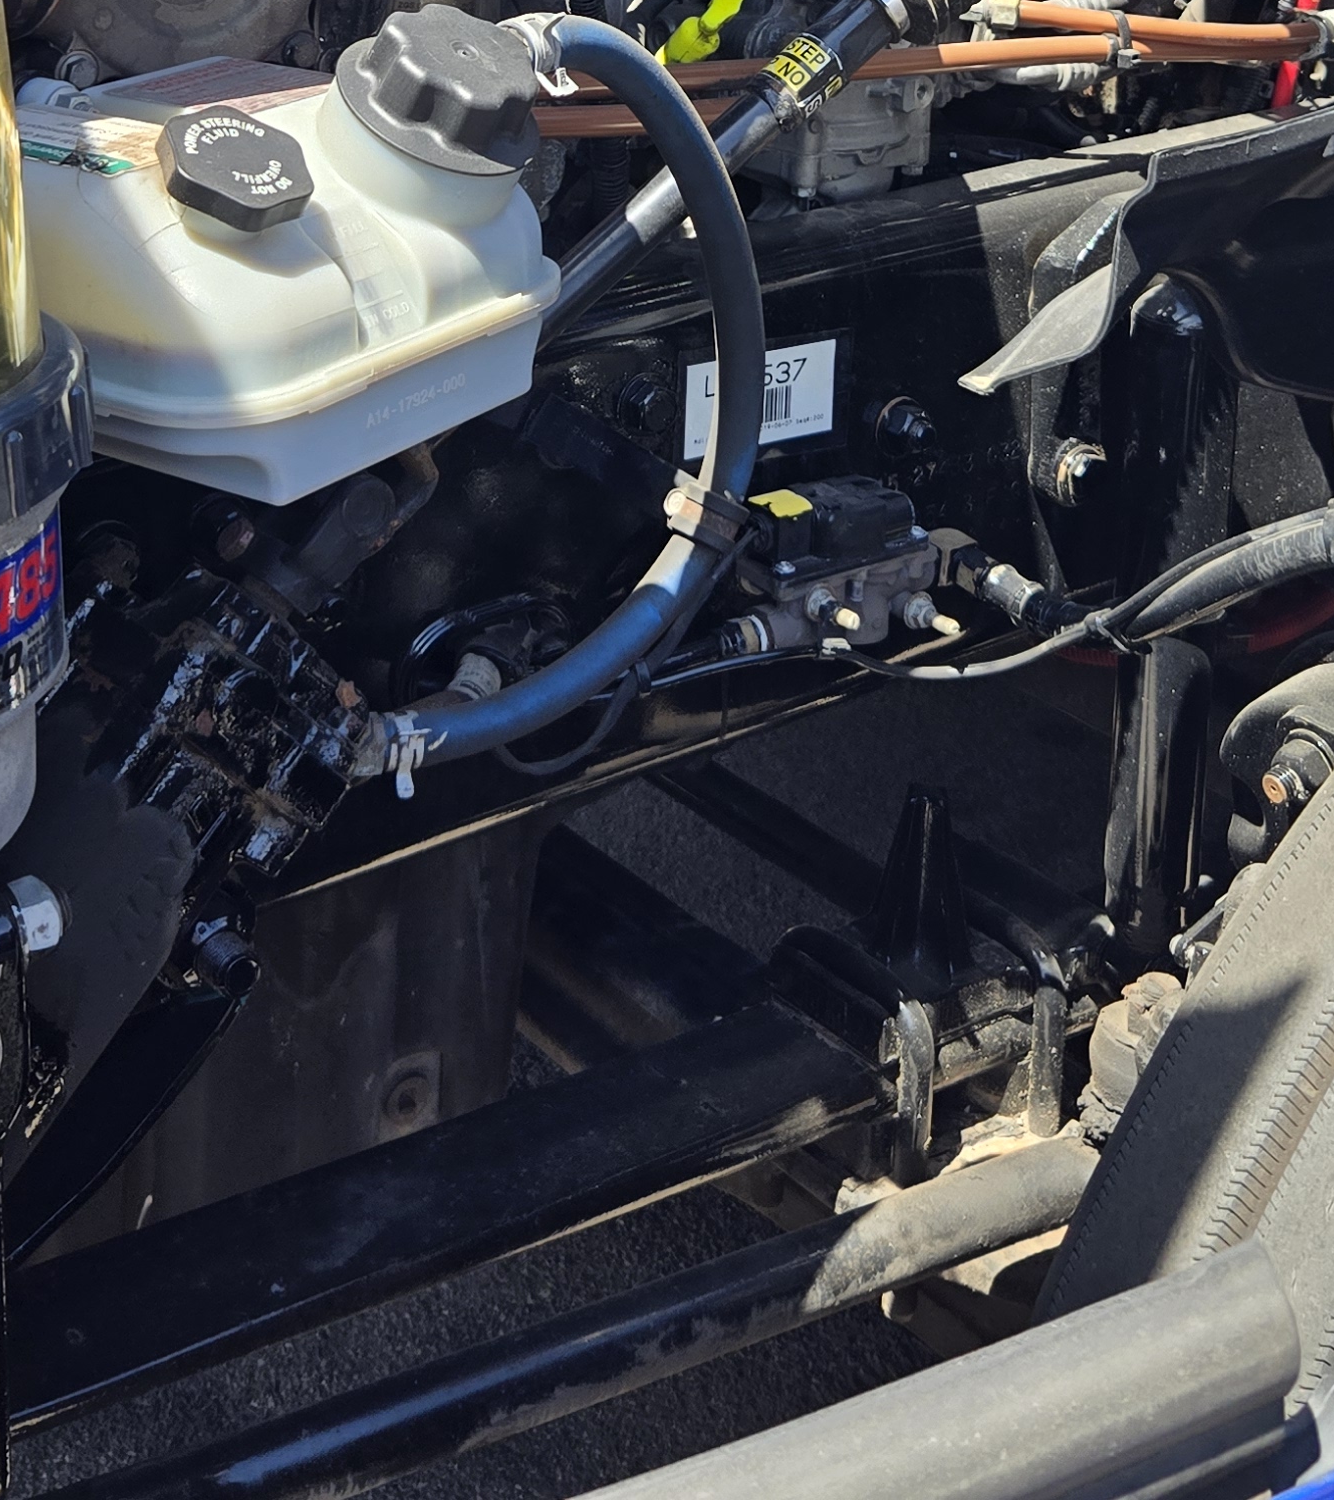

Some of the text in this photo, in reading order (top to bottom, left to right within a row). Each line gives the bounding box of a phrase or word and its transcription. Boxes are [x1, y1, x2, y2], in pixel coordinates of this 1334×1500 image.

[786, 39, 826, 65] STEP
[778, 61, 805, 86] NO
[184, 117, 265, 154] POWER STEERING
[201, 128, 239, 145] FLUID
[232, 160, 282, 184] OVERFILL
[251, 177, 293, 194] DO NOT
[705, 357, 807, 397] L537
